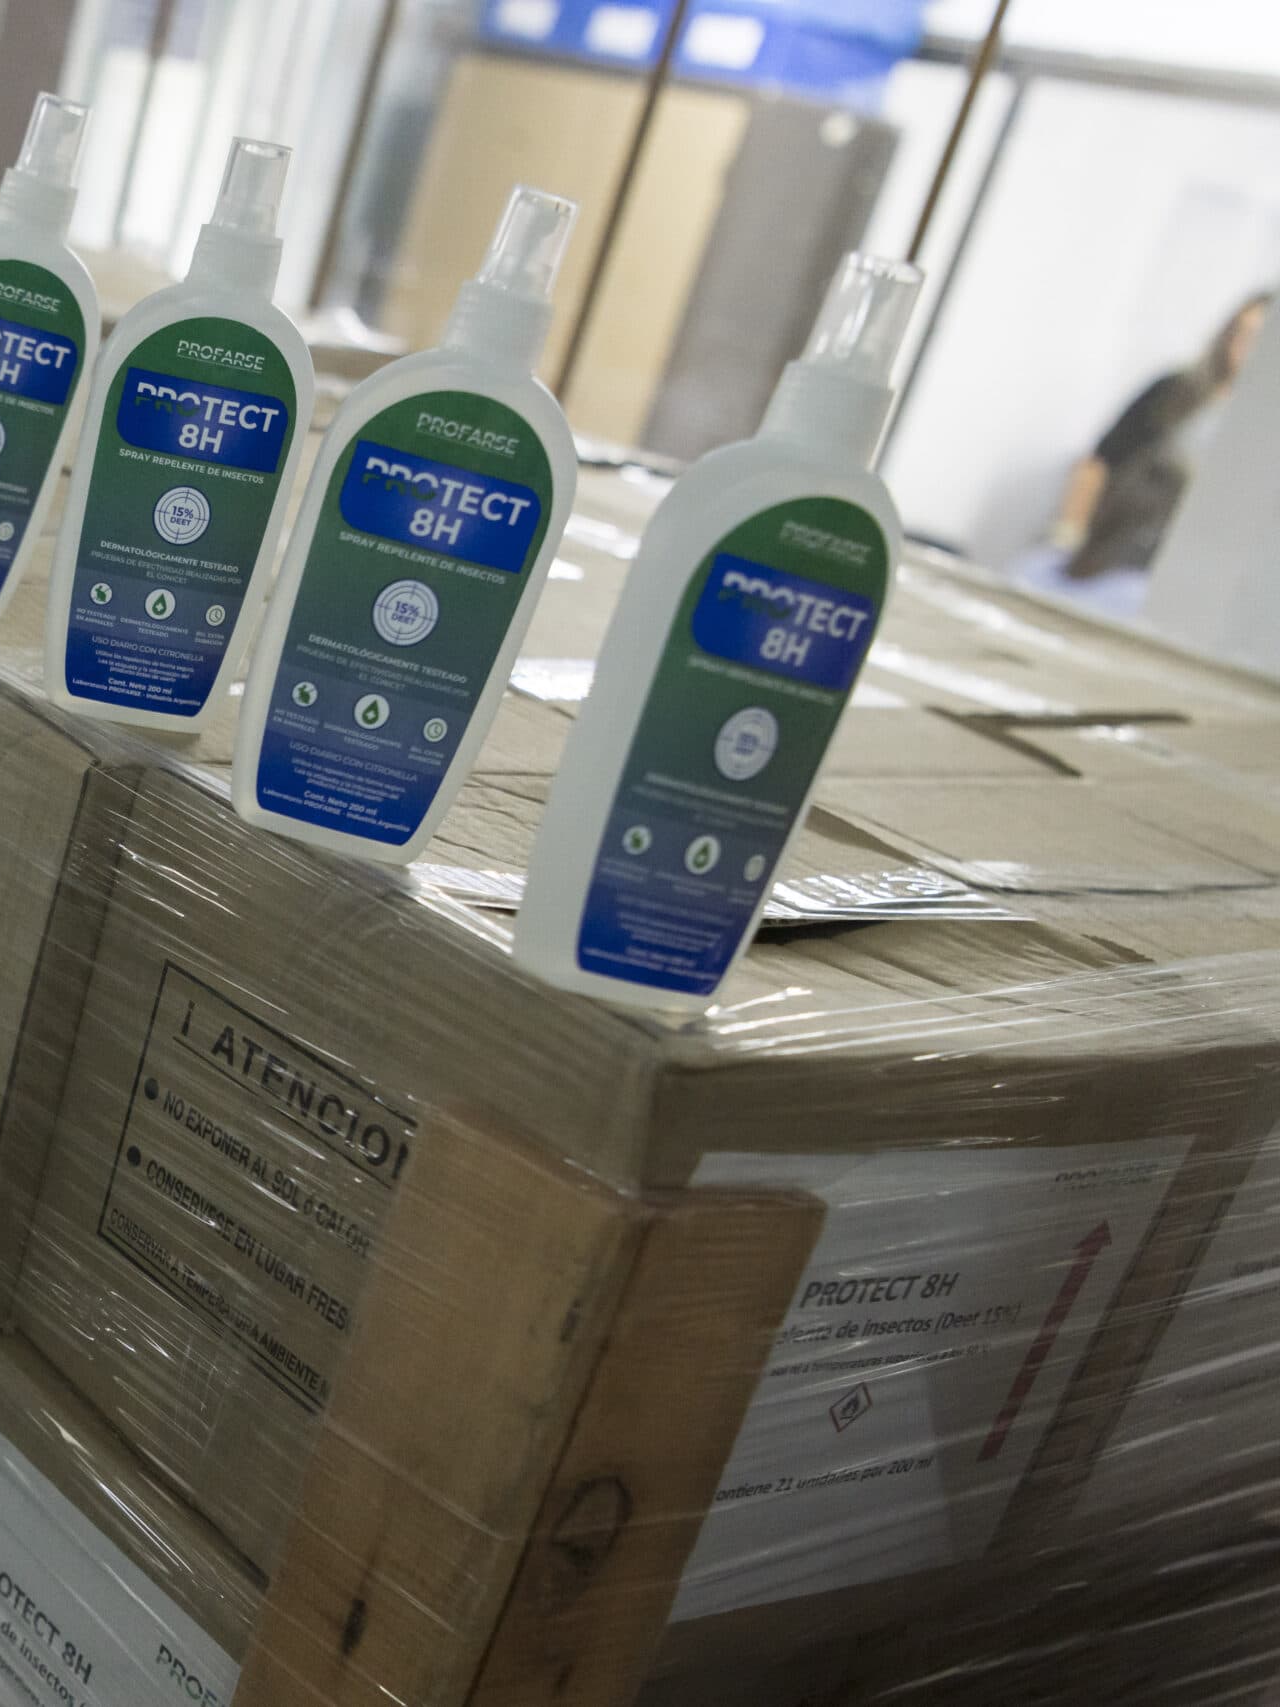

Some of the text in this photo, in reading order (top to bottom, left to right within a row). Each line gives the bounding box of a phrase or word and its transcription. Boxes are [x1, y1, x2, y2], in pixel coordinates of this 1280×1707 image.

[176, 339, 265, 370] PROFARSE
[133, 381, 279, 434] PROTECT
[176, 421, 224, 454] 8H
[416, 411, 519, 455] PROFARSE
[118, 447, 264, 485] SPRAY REPELENTE DE INSECTOS
[362, 455, 531, 528] PROTECT
[169, 516, 192, 527] DEET
[170, 505, 194, 519] 15%
[406, 506, 463, 546] 8H
[199, 559, 239, 573] TESTEADO
[338, 530, 506, 585] SPRAY REPELENTE DE INSECTOS
[394, 600, 420, 617] 15%
[719, 571, 869, 642] PROTECT
[91, 635, 204, 663] USO DIARIO CON CITRONELLA
[759, 627, 811, 668] 8H
[161, 1089, 185, 1123] NO
[184, 1105, 252, 1171] EXPONER
[249, 1153, 269, 1183] AL
[269, 1168, 303, 1209] SOL
[233, 1224, 258, 1260] EN
[305, 1282, 354, 1335] FRES
[800, 1272, 960, 1309] PROTECT 8H
[835, 1320, 858, 1340] de
[862, 1317, 933, 1338] insectos
[715, 1483, 773, 1501] ontiene
[774, 1477, 794, 1493] 21
[0, 1615, 18, 1643] de
[19, 1637, 74, 1706] insectos
[62, 1640, 93, 1685] 8H
[156, 1643, 227, 1707] PROF
